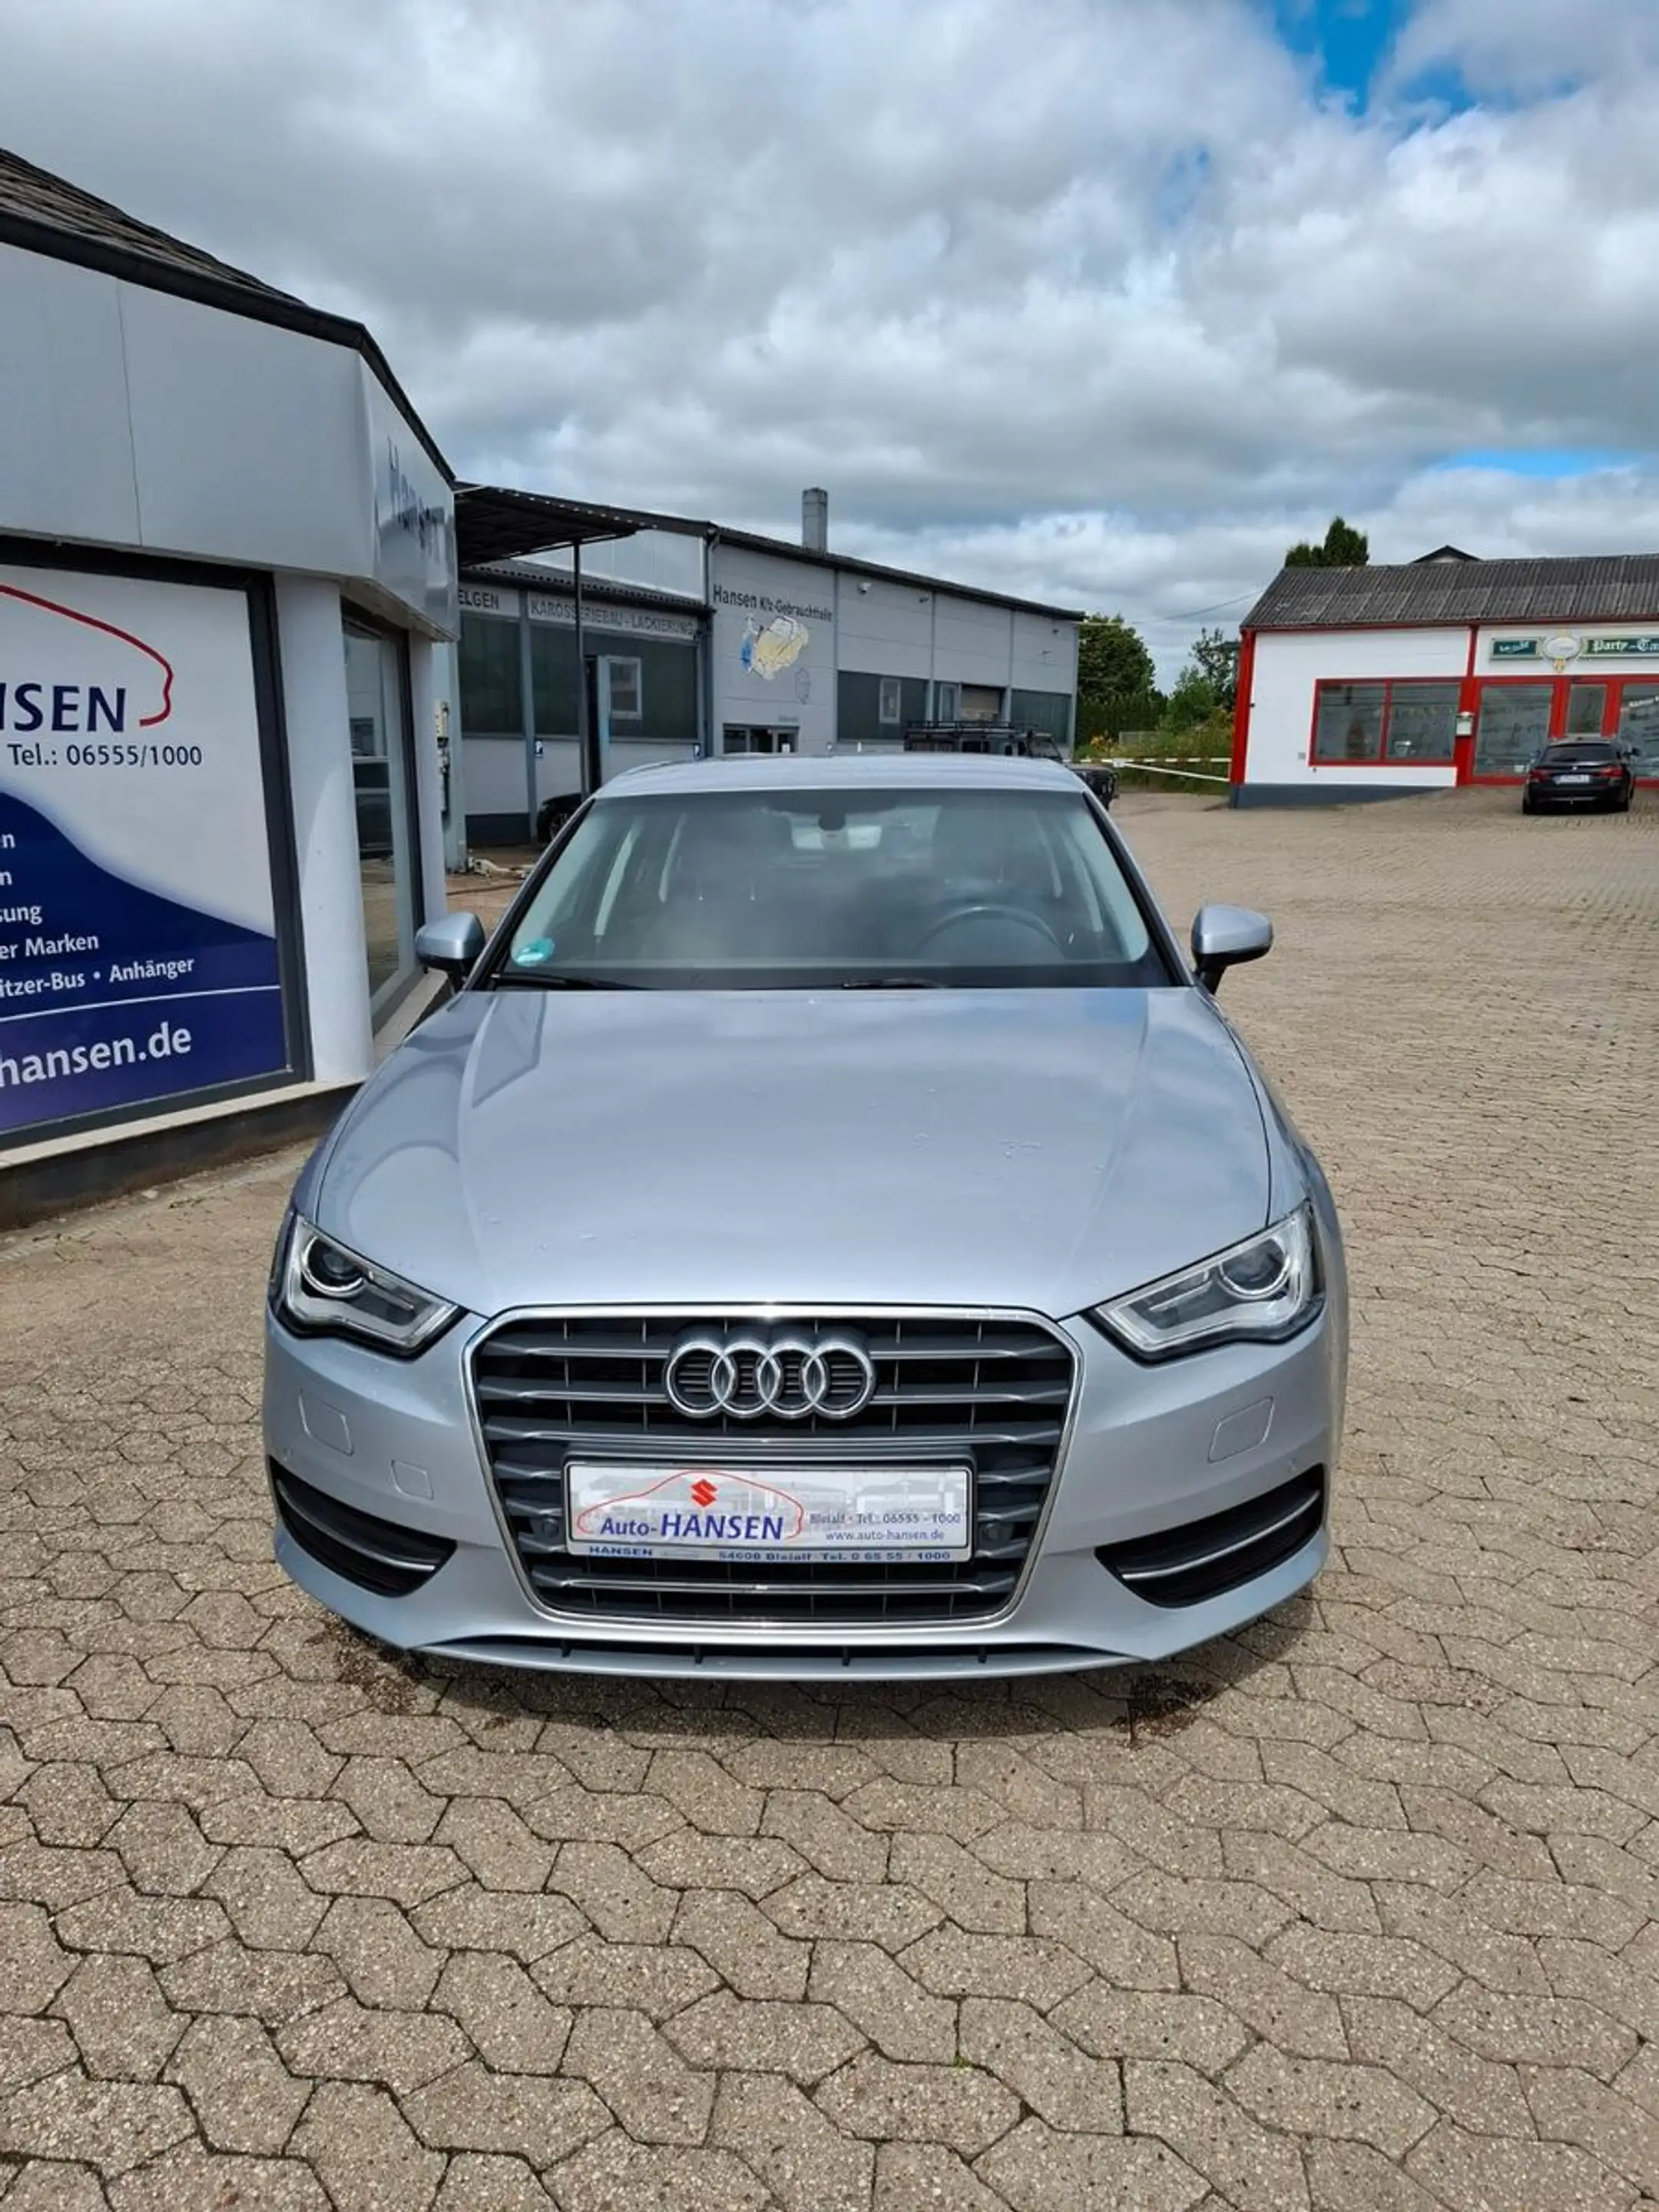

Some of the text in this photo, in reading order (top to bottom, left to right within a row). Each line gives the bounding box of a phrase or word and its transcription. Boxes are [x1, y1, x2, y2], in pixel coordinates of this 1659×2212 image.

[713, 584, 757, 609] Hansen
[0, 682, 126, 733] SEN
[7, 743, 203, 767] Tel.: 06555/1000
[0, 905, 42, 926] ung
[25, 933, 99, 957] Marken
[109, 958, 195, 983] Anhänger
[600, 1513, 783, 1540] Auto-HANSEN
[883, 1513, 919, 1524] 06555
[932, 1513, 960, 1525] 1000
[826, 1529, 945, 1541] www.auto-hansen.de
[589, 1545, 652, 1556] HANSEN
[917, 1552, 951, 1561] 1000
